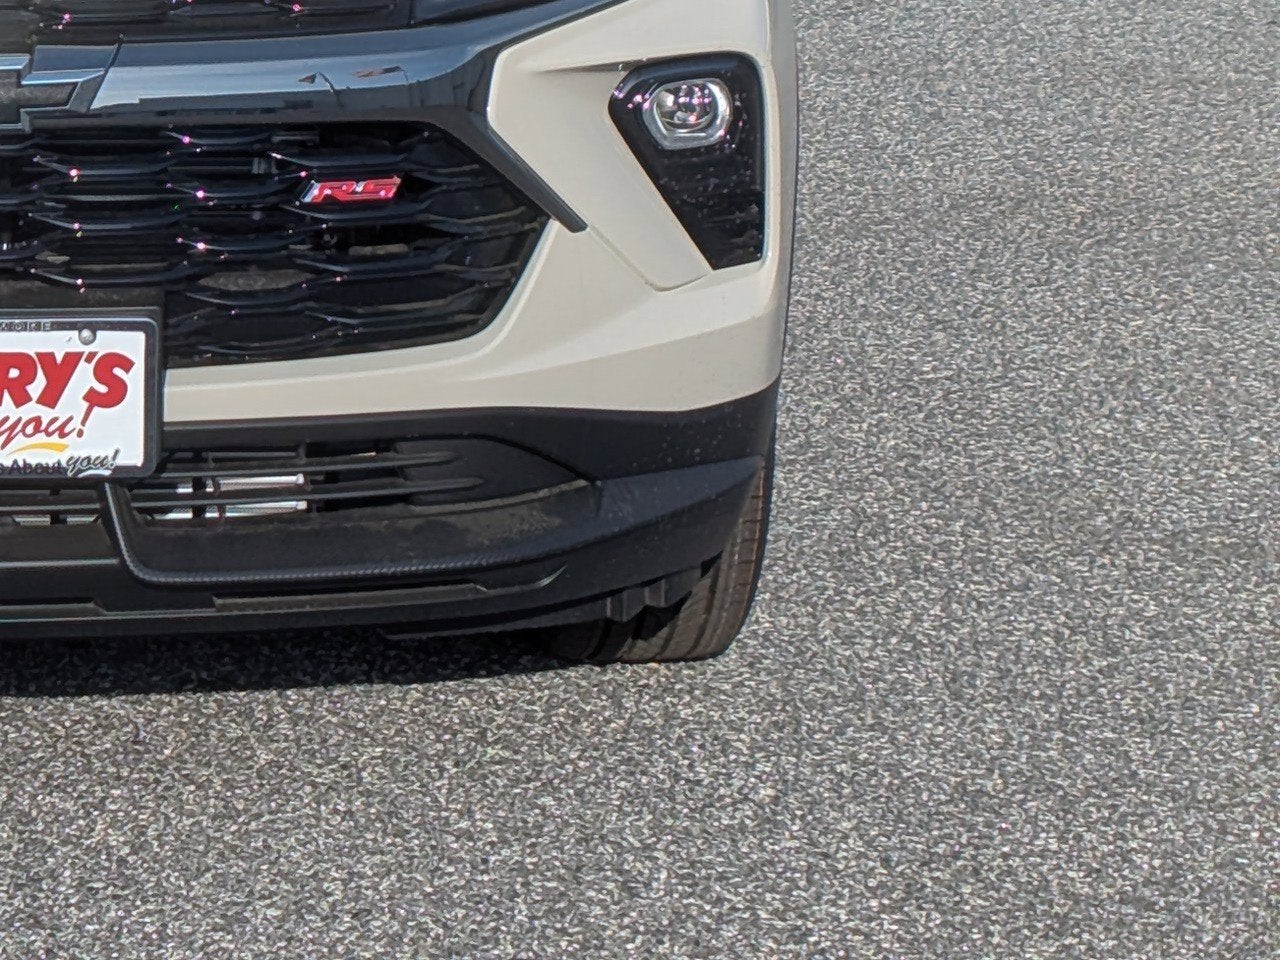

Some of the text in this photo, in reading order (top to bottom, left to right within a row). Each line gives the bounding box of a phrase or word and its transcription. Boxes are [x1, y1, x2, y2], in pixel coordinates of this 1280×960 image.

[302, 177, 402, 203] RS
[7, 458, 65, 476] About
[65, 448, 121, 477] you!
